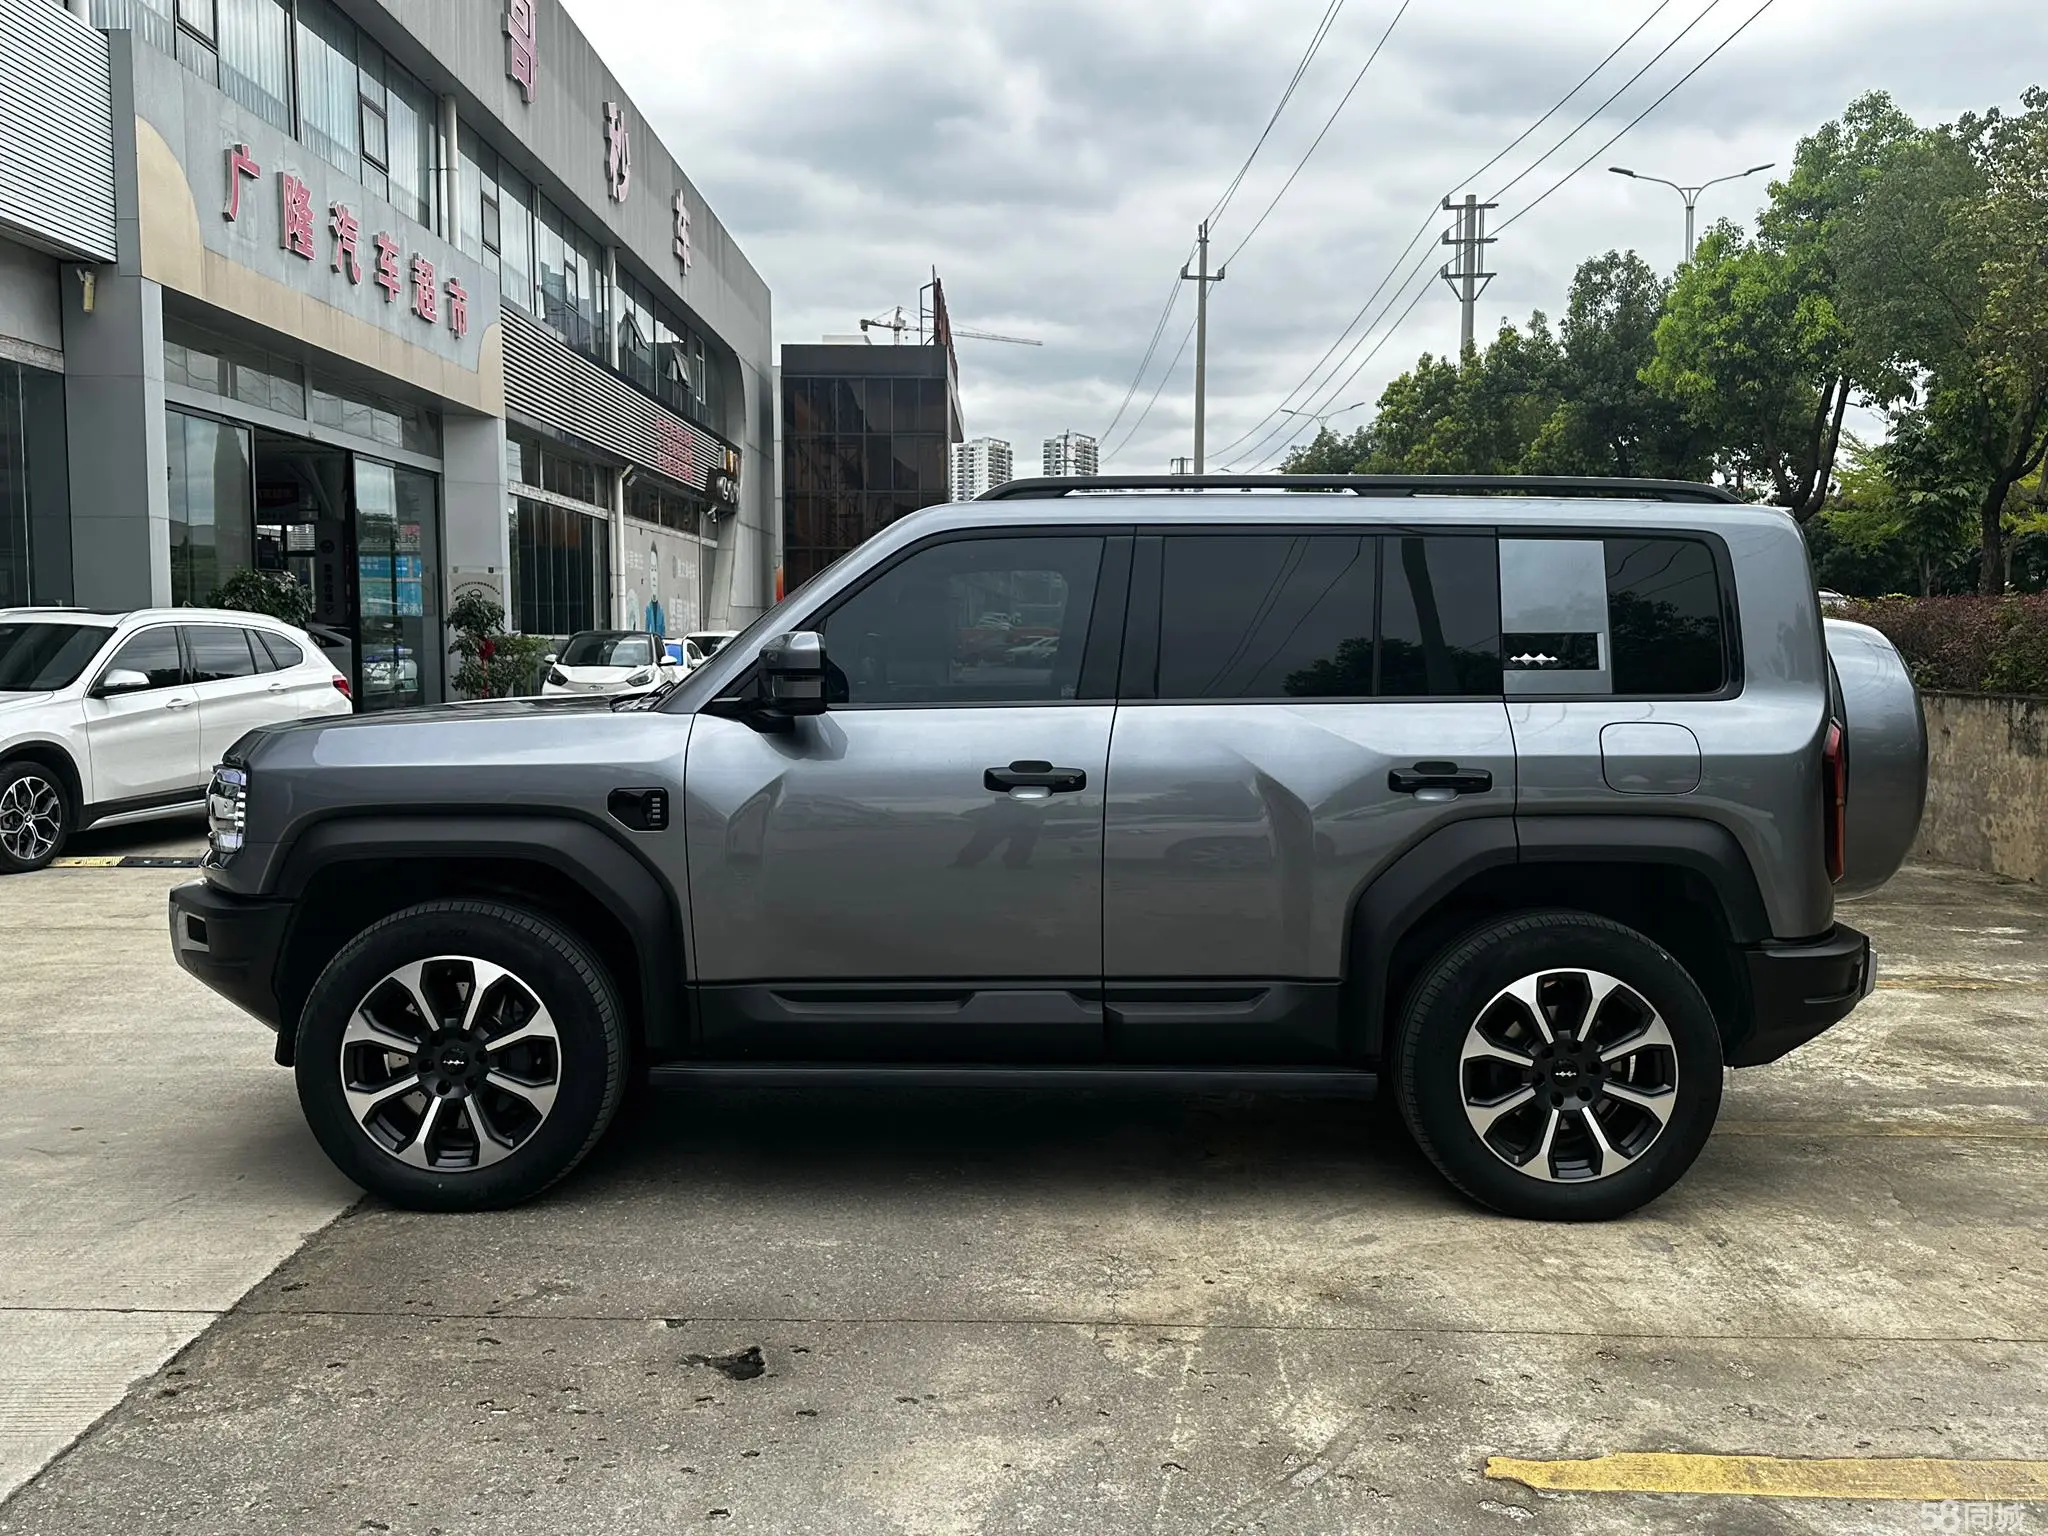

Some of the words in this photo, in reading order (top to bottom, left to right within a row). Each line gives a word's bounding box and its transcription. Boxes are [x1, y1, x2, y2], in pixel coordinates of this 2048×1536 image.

[222, 143, 468, 339] 广隆汽车超市
